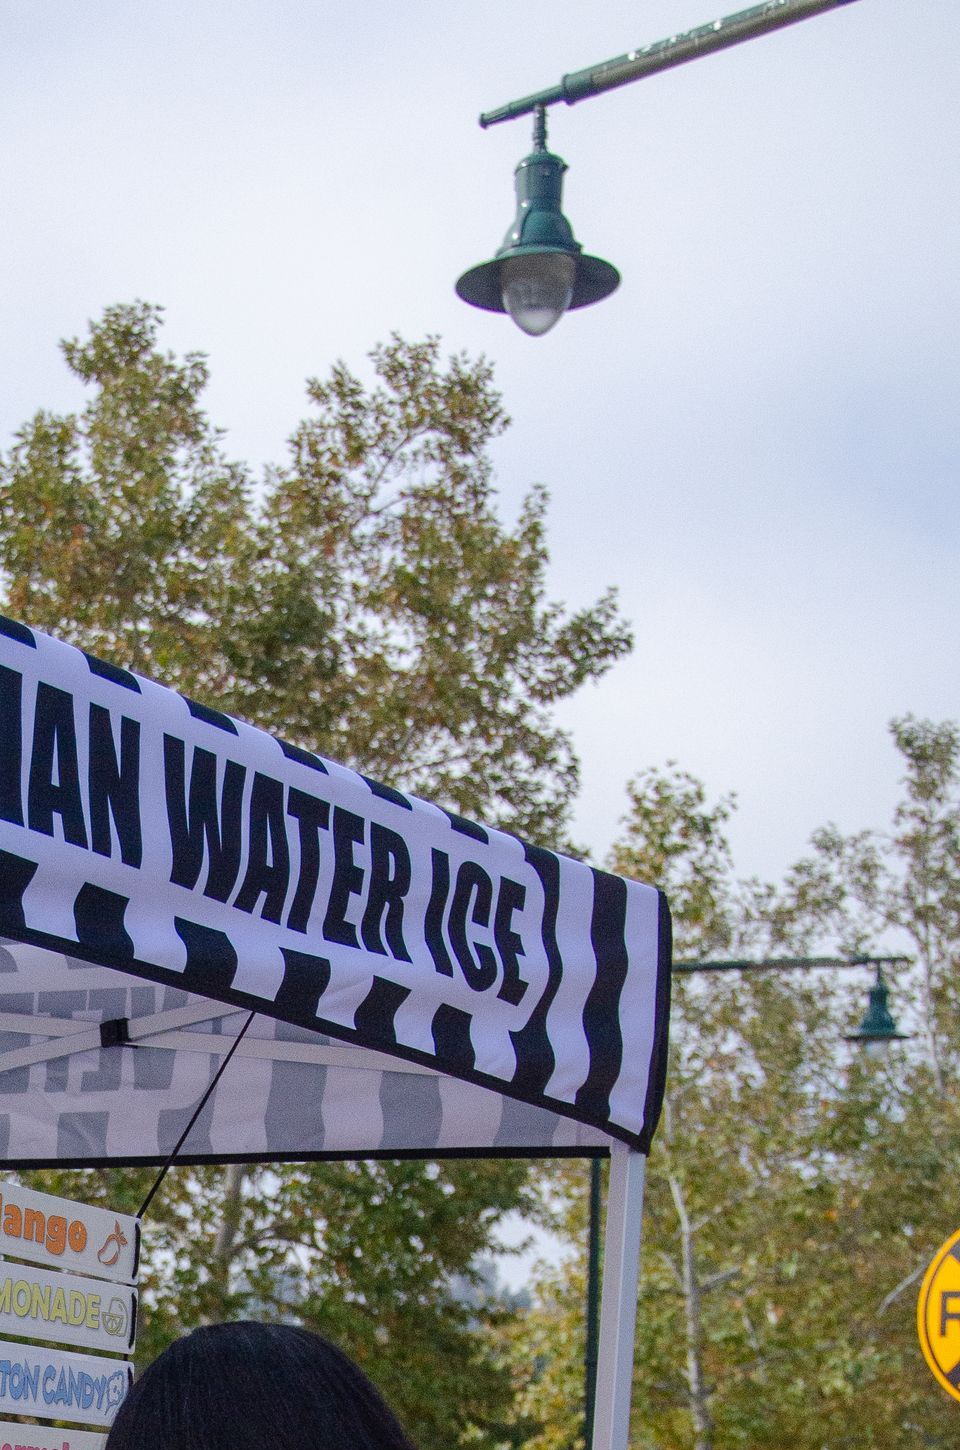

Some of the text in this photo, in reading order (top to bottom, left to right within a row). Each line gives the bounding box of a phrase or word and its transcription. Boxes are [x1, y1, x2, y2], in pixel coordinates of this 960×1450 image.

[163, 732, 412, 962] WATER
[423, 849, 528, 1005] ICE
[42, 1364, 107, 1411] CANDY
